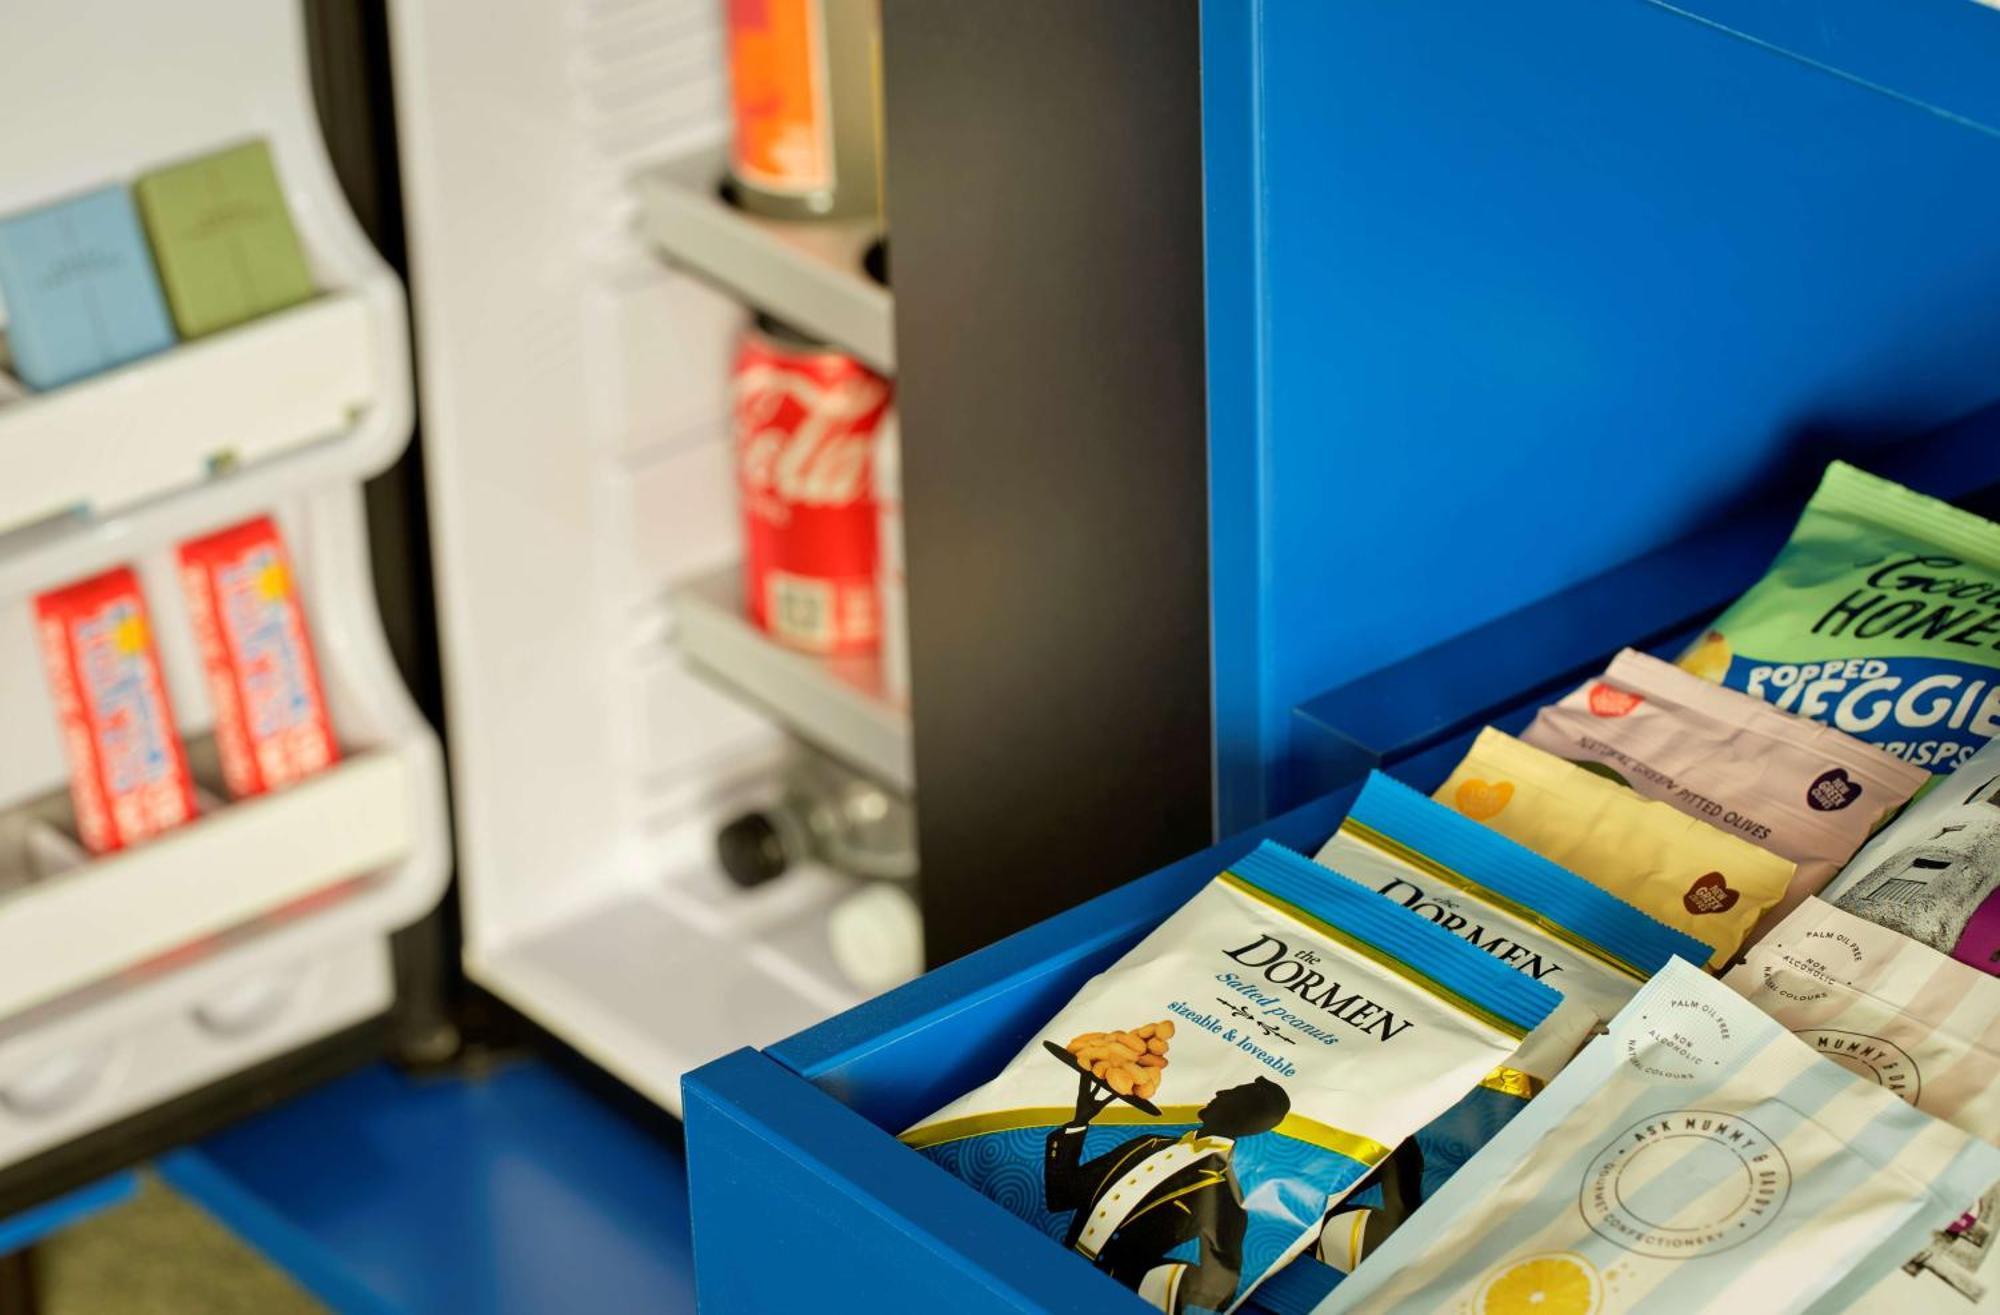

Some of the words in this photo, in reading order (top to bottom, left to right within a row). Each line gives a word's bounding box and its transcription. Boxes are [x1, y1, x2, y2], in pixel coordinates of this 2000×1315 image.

[1810, 588, 2000, 652] HONE
[1749, 659, 1889, 690] POPPED
[1677, 788, 1723, 818] PITTED
[1722, 810, 1773, 841] OLIVES
[1294, 949, 1321, 966] the
[1806, 931, 1834, 939] PALM
[1836, 934, 1851, 945] OIL
[1850, 943, 1863, 962] FREE
[1782, 955, 1837, 986] ALCOHOLIC
[1806, 958, 1828, 972] NON
[1222, 934, 1415, 1043] DORMEN
[1779, 990, 1829, 1002] COLOURS
[1215, 971, 1281, 1008] Salted
[1263, 1005, 1339, 1047] peanuts
[1671, 999, 1699, 1008] PALM
[1701, 1004, 1717, 1019] OIL
[1717, 1017, 1731, 1040] FREE
[1167, 1000, 1223, 1035] sizeable
[1222, 1028, 1238, 1043] &
[1236, 1035, 1297, 1078] loveable
[1648, 1029, 1704, 1066] ALCOHOLIC
[1817, 1036, 1889, 1063] MUMMY
[1634, 1120, 1673, 1143] ASK
[1684, 1117, 1757, 1150] MUMMY
[1602, 1213, 1725, 1249] CONFECTIONERY
